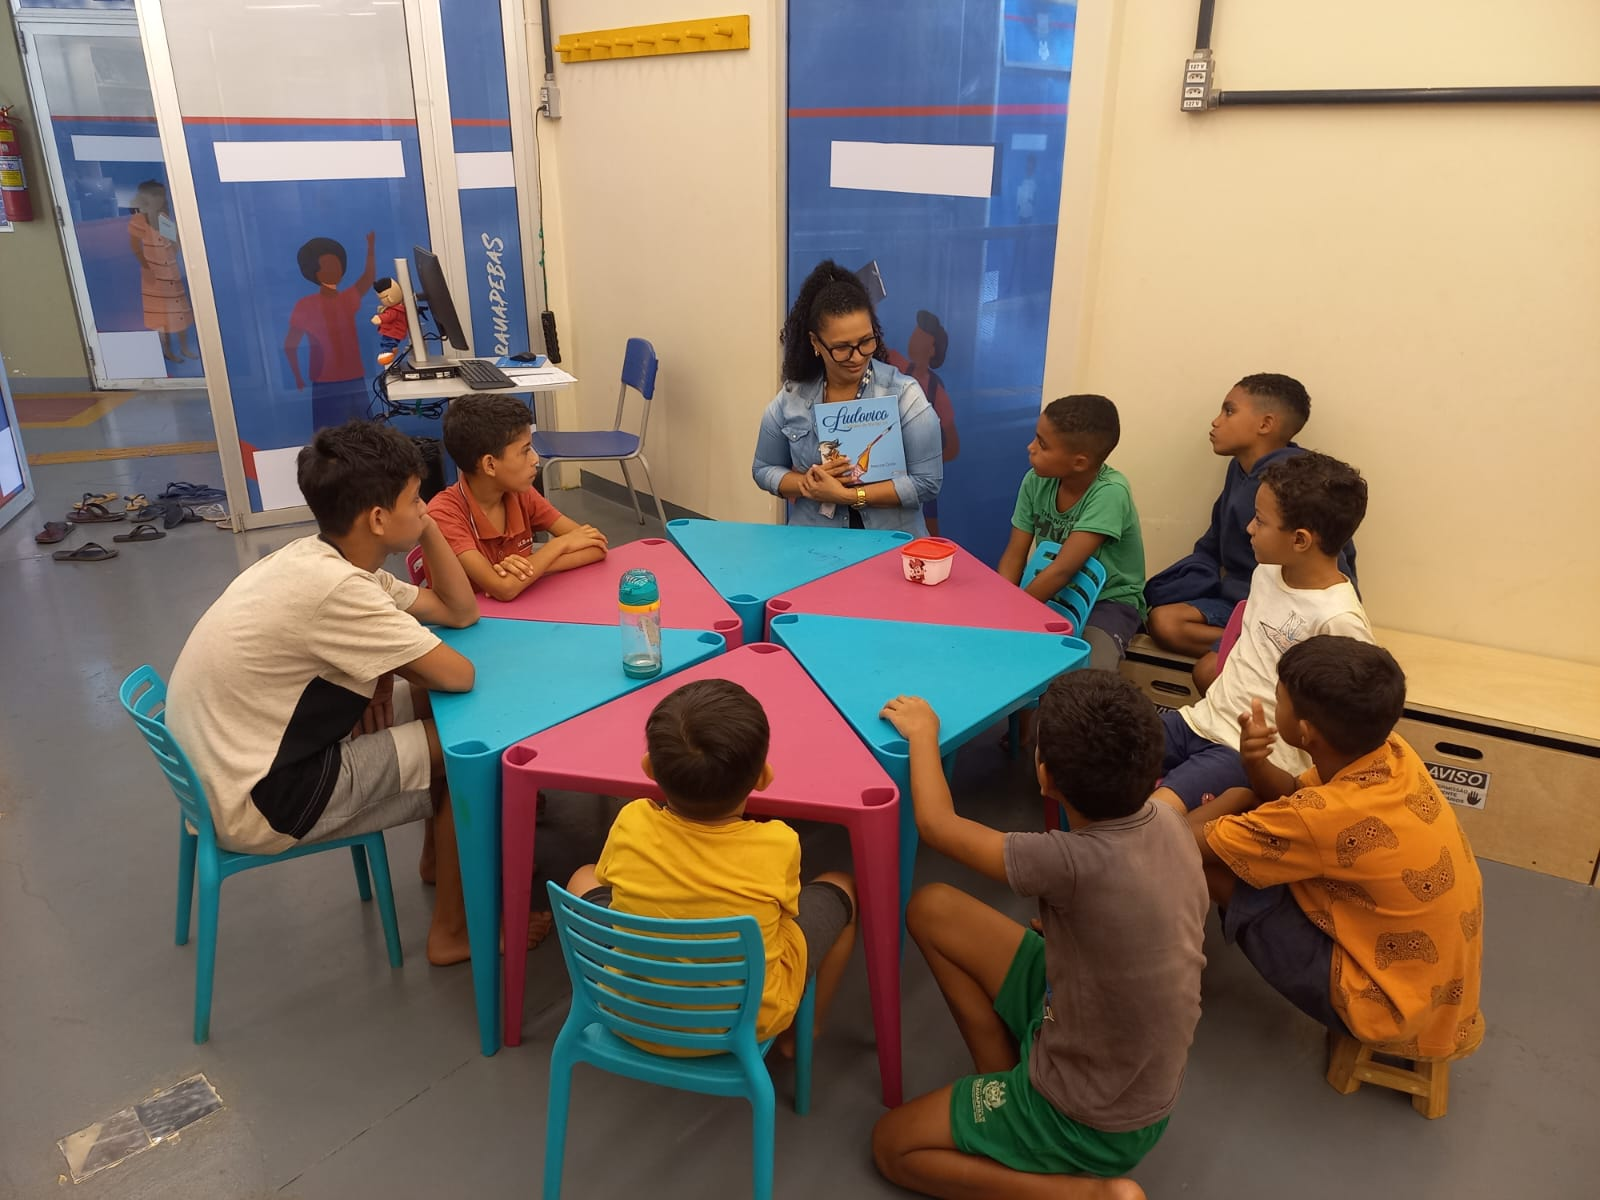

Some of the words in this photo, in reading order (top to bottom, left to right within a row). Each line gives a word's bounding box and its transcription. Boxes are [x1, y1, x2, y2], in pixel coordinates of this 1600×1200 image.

[481, 232, 510, 356] RAUAPEBAS
[822, 406, 889, 433] Ludovico
[1429, 766, 1483, 786] AVISO
